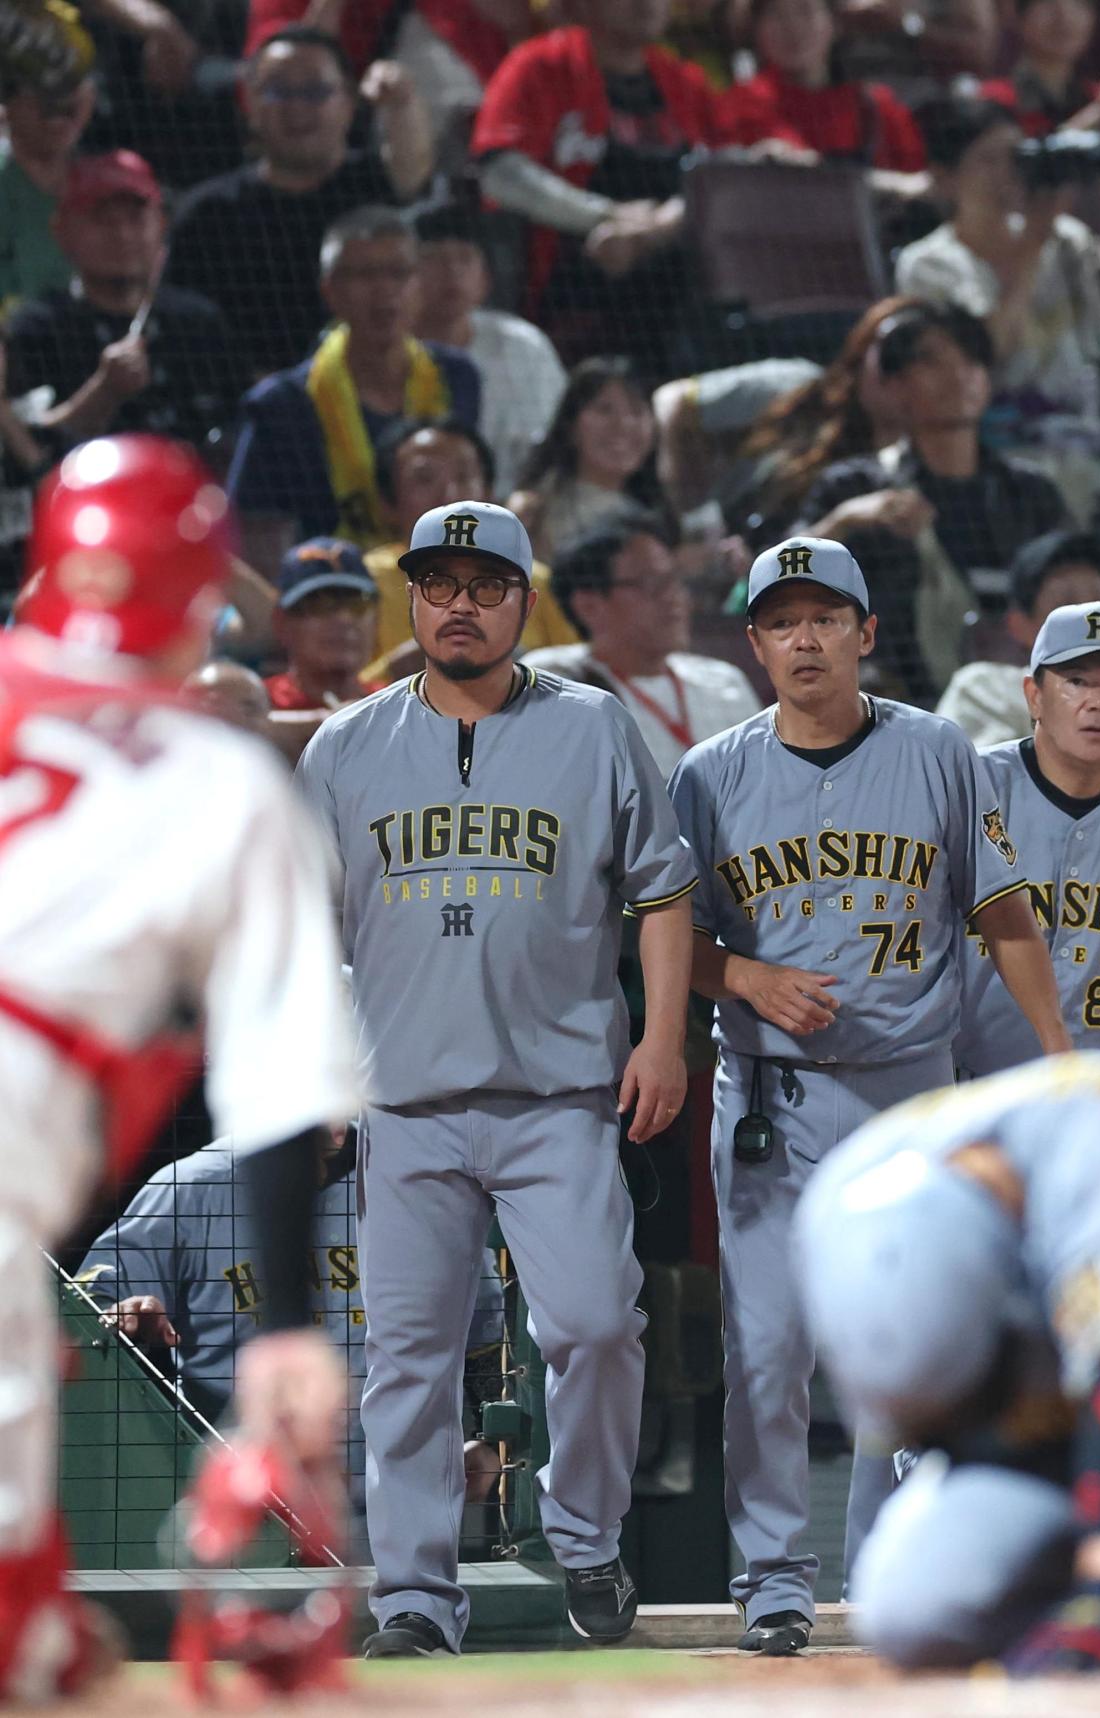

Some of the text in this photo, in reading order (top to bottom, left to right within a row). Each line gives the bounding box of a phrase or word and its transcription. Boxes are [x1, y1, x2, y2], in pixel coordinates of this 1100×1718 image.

[369, 804, 560, 876] TIGERS
[715, 830, 938, 905] HANSHIN
[383, 876, 544, 904] BASEBALL
[744, 893, 917, 921] TIGERS
[860, 919, 924, 976] 74
